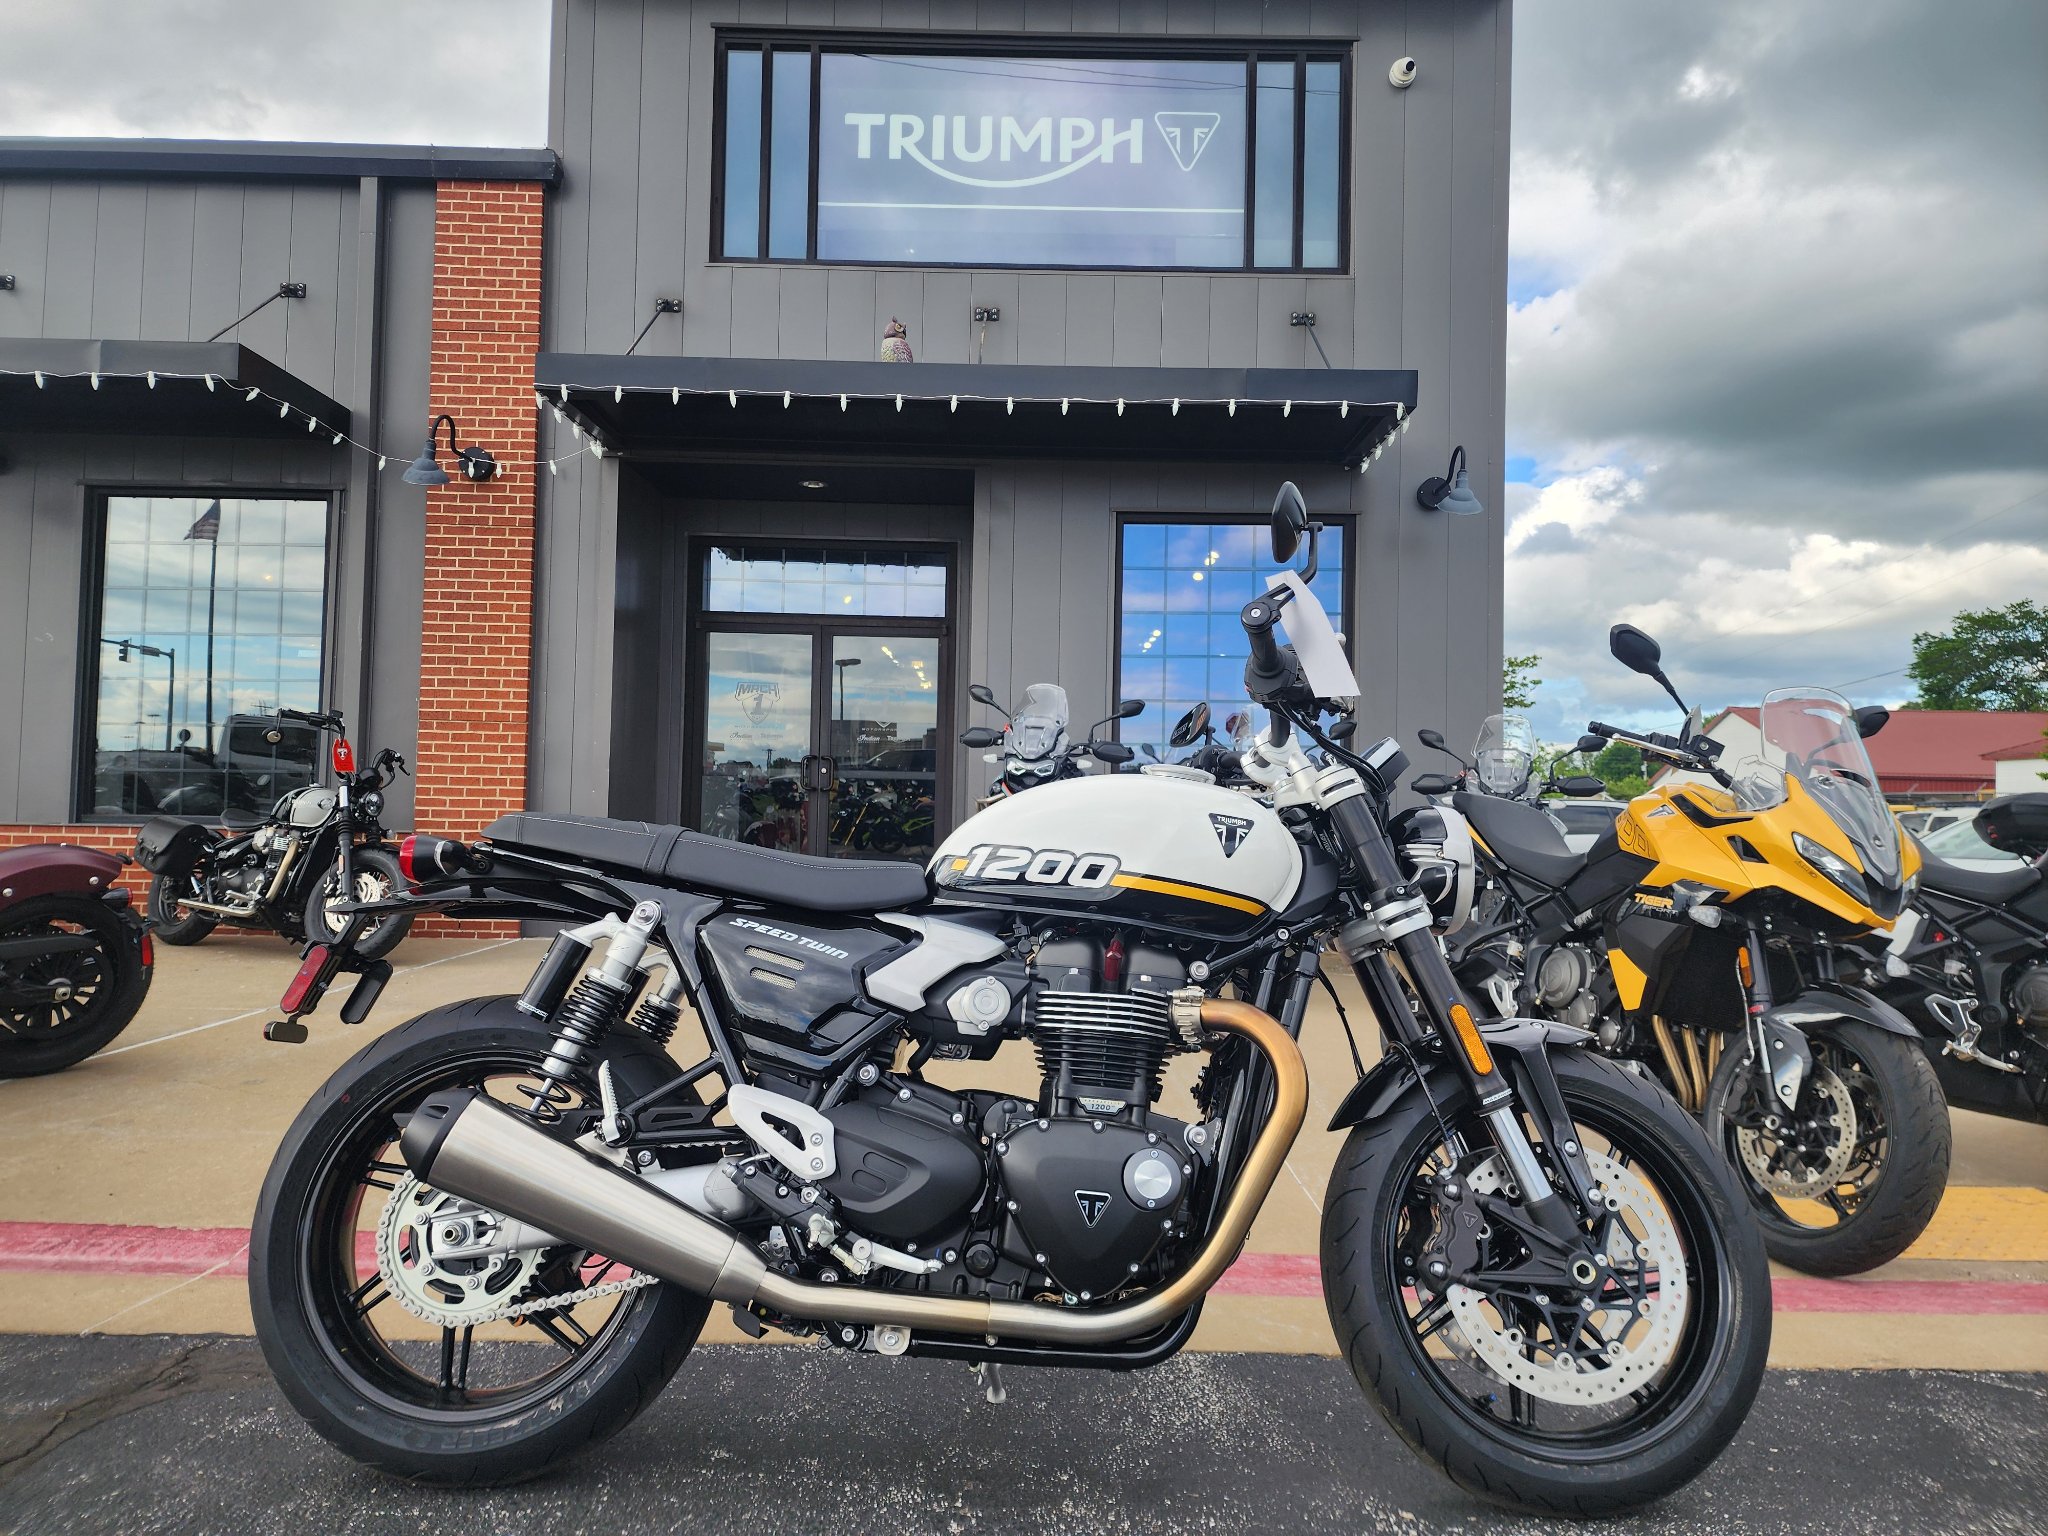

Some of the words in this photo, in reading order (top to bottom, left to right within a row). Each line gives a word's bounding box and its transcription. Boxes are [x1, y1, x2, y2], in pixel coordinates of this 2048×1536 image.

[844, 112, 1143, 187] TRIUMPH
[737, 684, 778, 697] MACH
[1216, 816, 1247, 827] TRIUMPH
[963, 846, 1118, 889] 1200
[1634, 892, 1674, 910] TIGER
[729, 918, 798, 941] SPEED
[798, 936, 848, 959] TWIN
[1091, 1103, 1111, 1111] 1200
